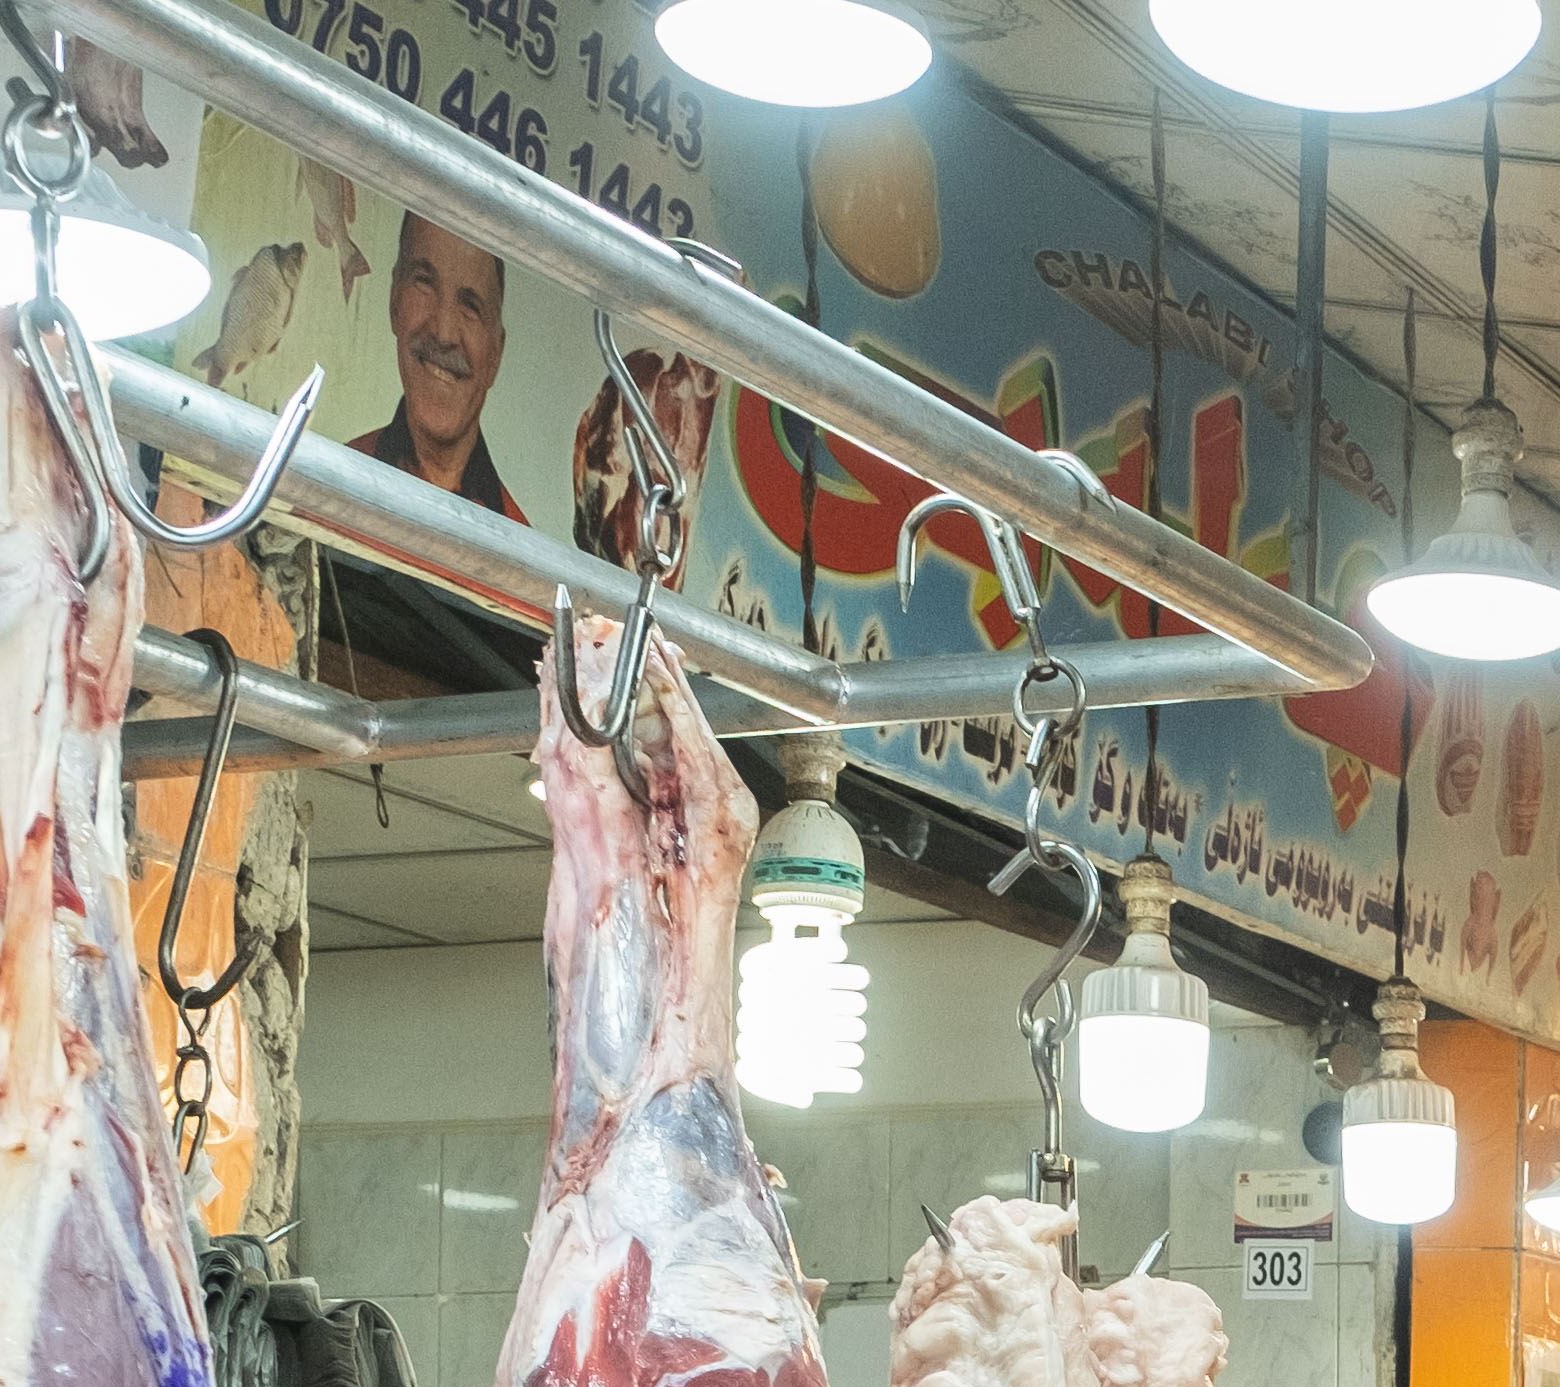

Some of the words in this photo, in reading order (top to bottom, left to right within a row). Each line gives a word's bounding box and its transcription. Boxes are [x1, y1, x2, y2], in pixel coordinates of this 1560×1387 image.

[440, 69, 548, 176] 446
[579, 31, 704, 164] 1443
[1034, 250, 1271, 366] CHALABI
[1289, 368, 1396, 516] HOP
[1251, 1251, 1302, 1287] 303
